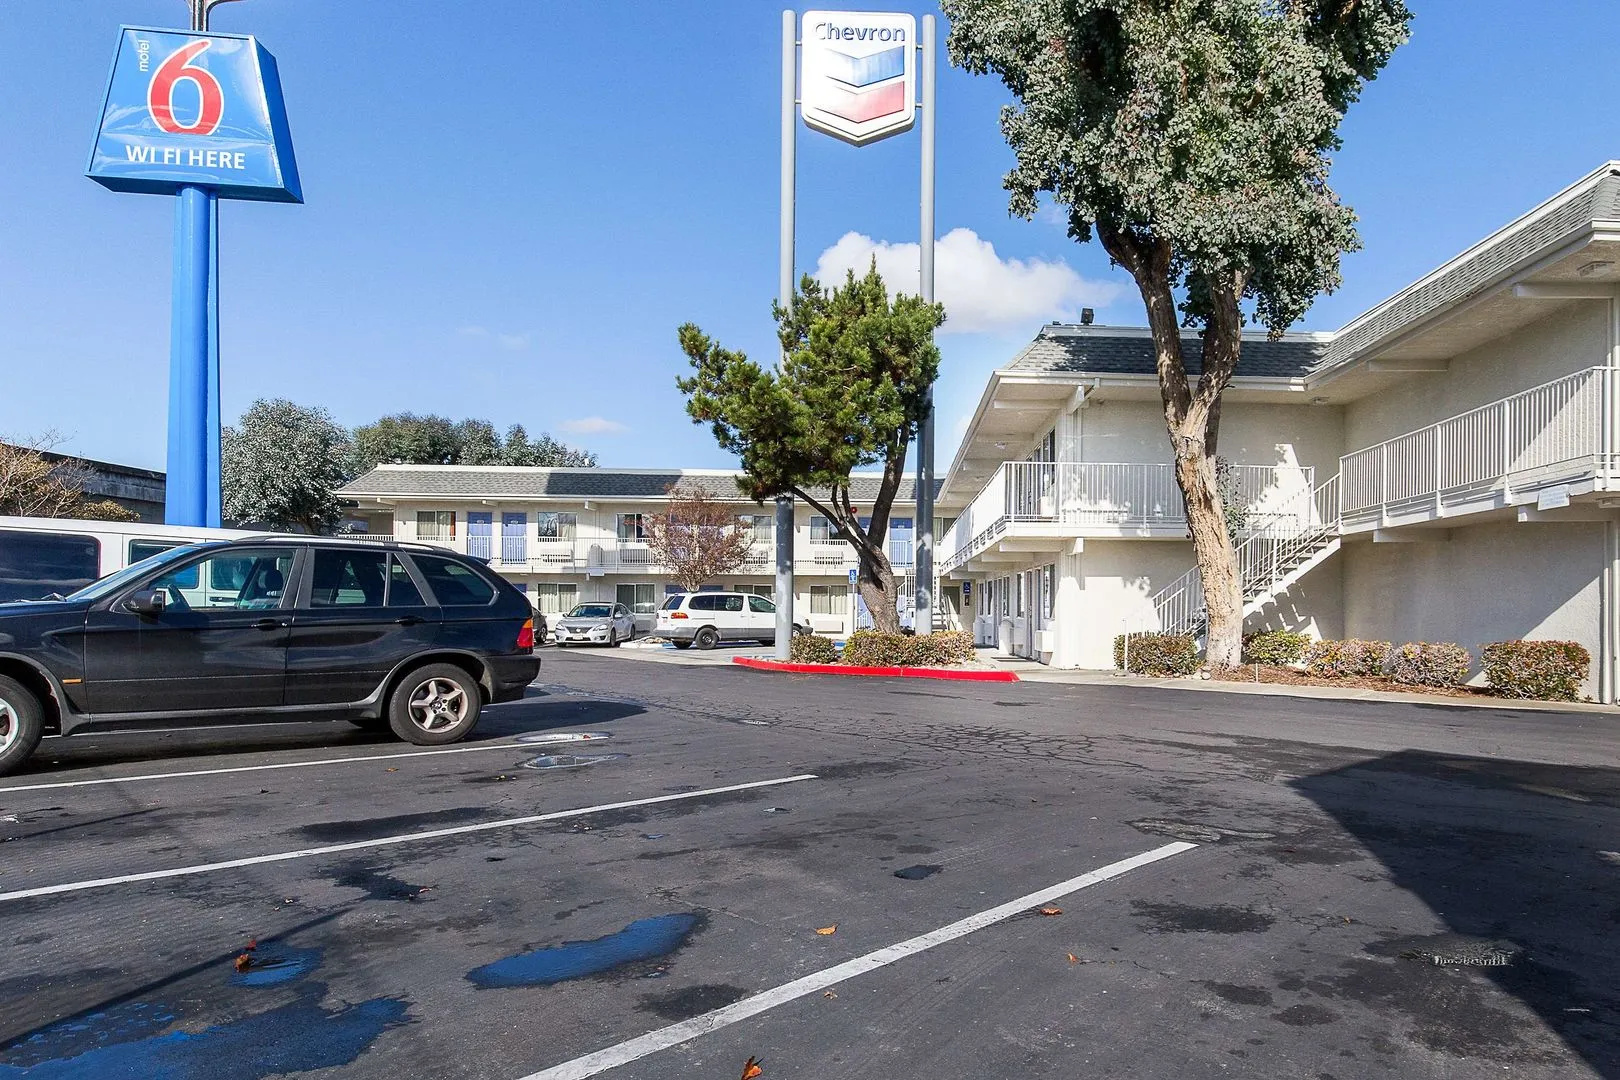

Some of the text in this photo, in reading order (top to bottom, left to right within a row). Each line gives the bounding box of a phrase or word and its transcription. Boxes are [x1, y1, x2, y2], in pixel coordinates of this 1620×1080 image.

[815, 22, 906, 42] Chevron
[137, 38, 224, 136] motel 6
[125, 144, 246, 170] WI FI HERE
